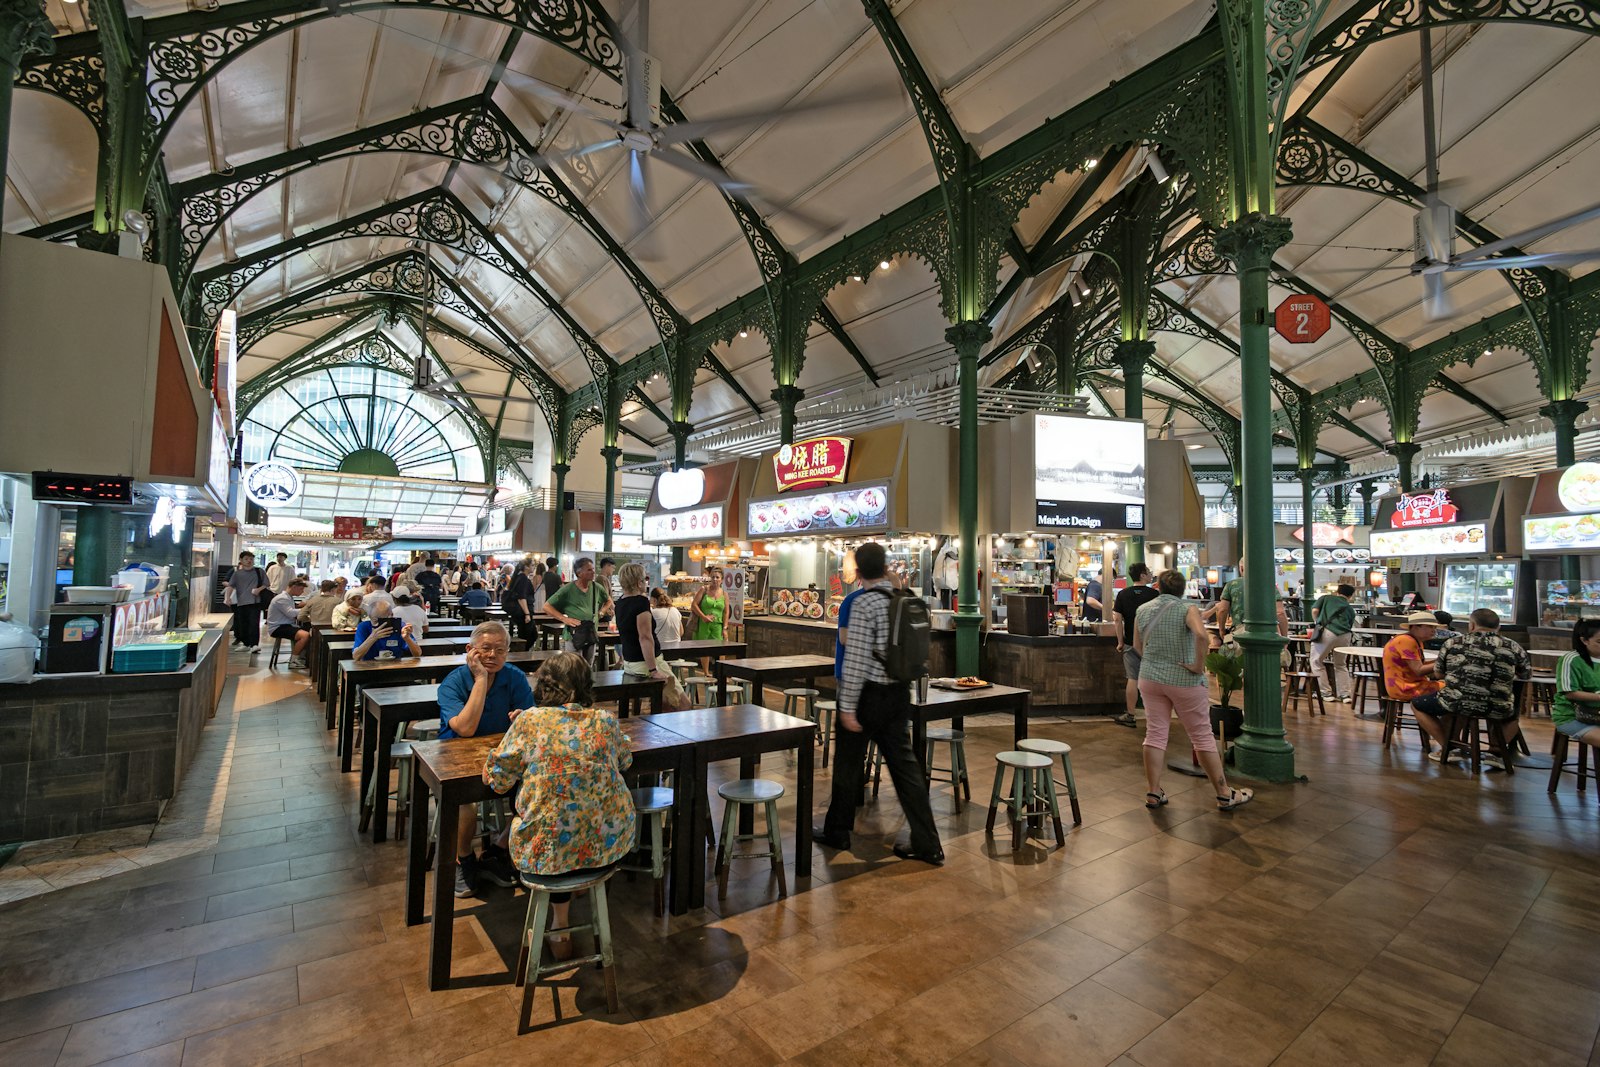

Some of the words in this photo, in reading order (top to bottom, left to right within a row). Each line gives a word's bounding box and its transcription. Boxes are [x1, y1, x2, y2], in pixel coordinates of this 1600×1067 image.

[1290, 303, 1314, 311] STREET
[1296, 312, 1309, 335] 2
[798, 470, 809, 478] KEE
[809, 465, 836, 477] ROASTED
[1038, 515, 1070, 525] Market
[1071, 516, 1101, 528] Design
